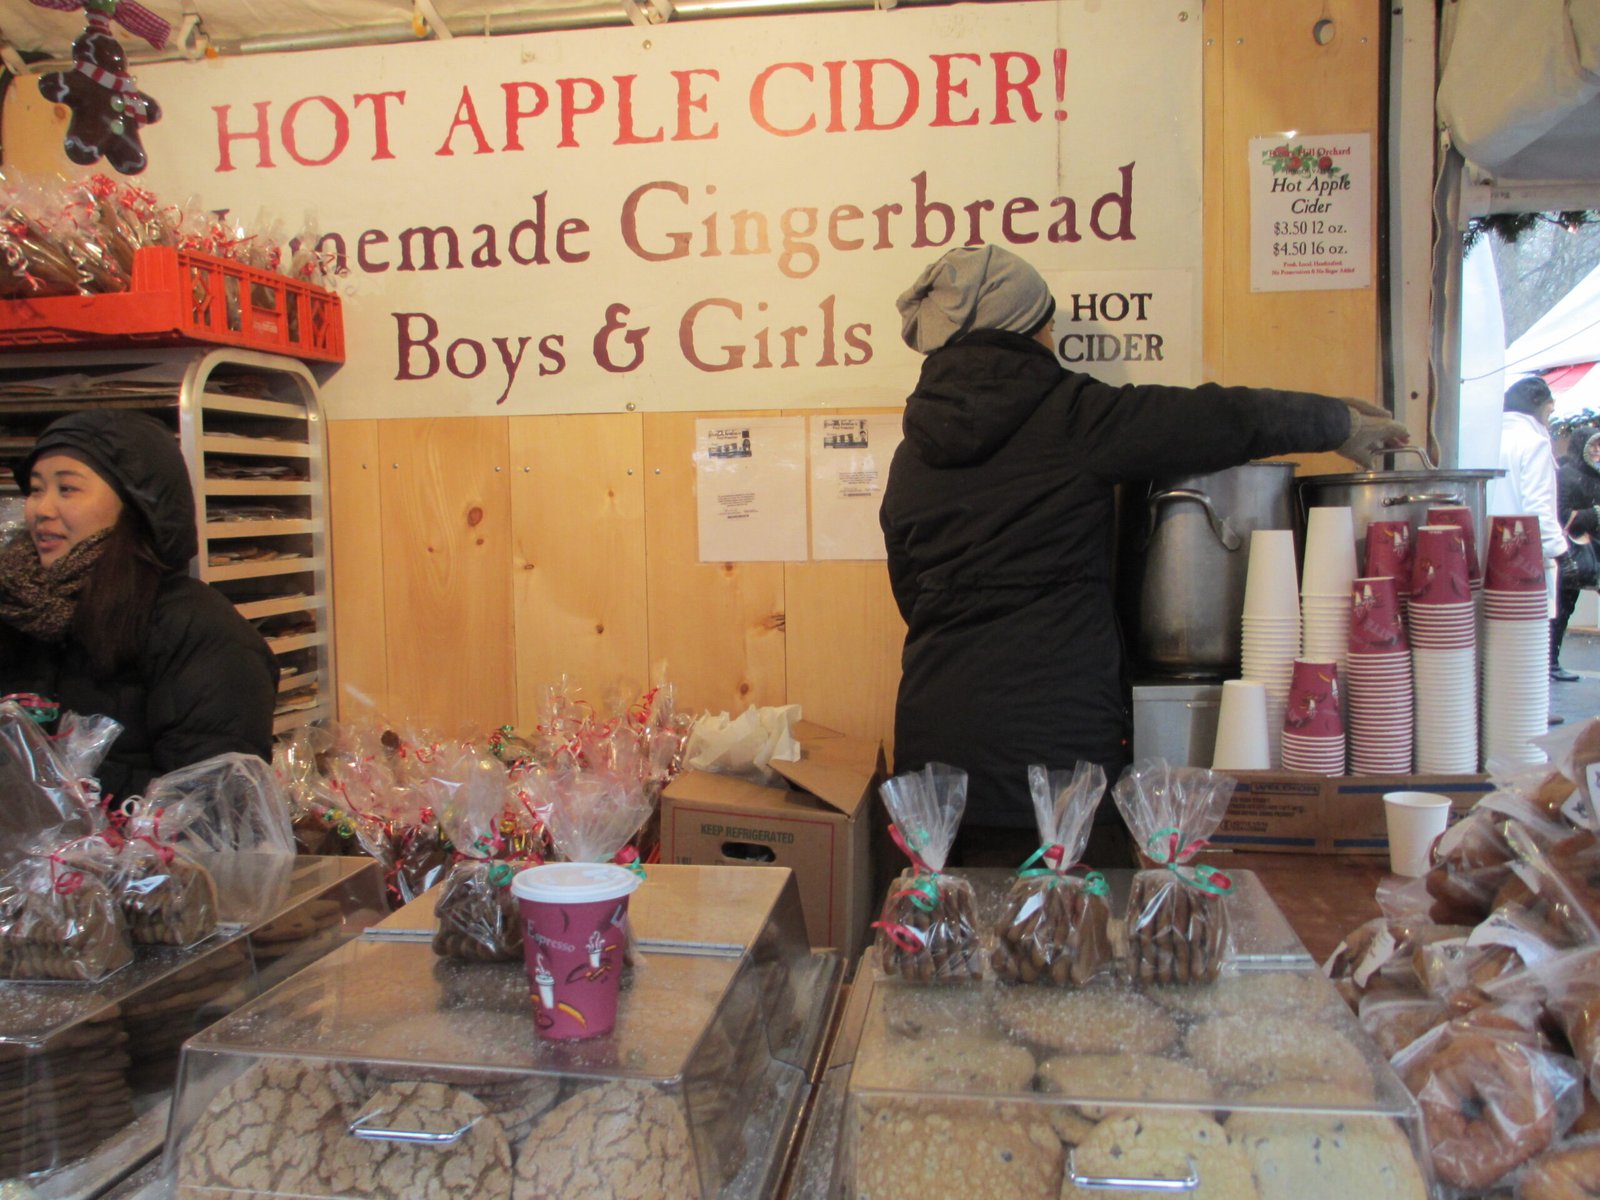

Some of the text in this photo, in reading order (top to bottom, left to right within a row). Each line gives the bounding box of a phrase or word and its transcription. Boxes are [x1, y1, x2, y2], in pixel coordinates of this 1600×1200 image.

[211, 48, 1068, 172] HOT APPLE CIDER!
[1316, 146, 1351, 156] Orchard
[1271, 175, 1351, 196] Hot Apple
[1291, 198, 1332, 214] Cider
[620, 161, 1136, 279] Gingerbread
[1273, 220, 1347, 236] $3.50 12 oz.
[1272, 241, 1348, 257] $4.50 16 oz.
[1071, 293, 1152, 322] HOT
[391, 294, 874, 405] Boys & Girls
[1058, 333, 1164, 362] CIDER
[701, 823, 795, 844] KEEP REFRIGERATED
[527, 919, 577, 953] Espresso
